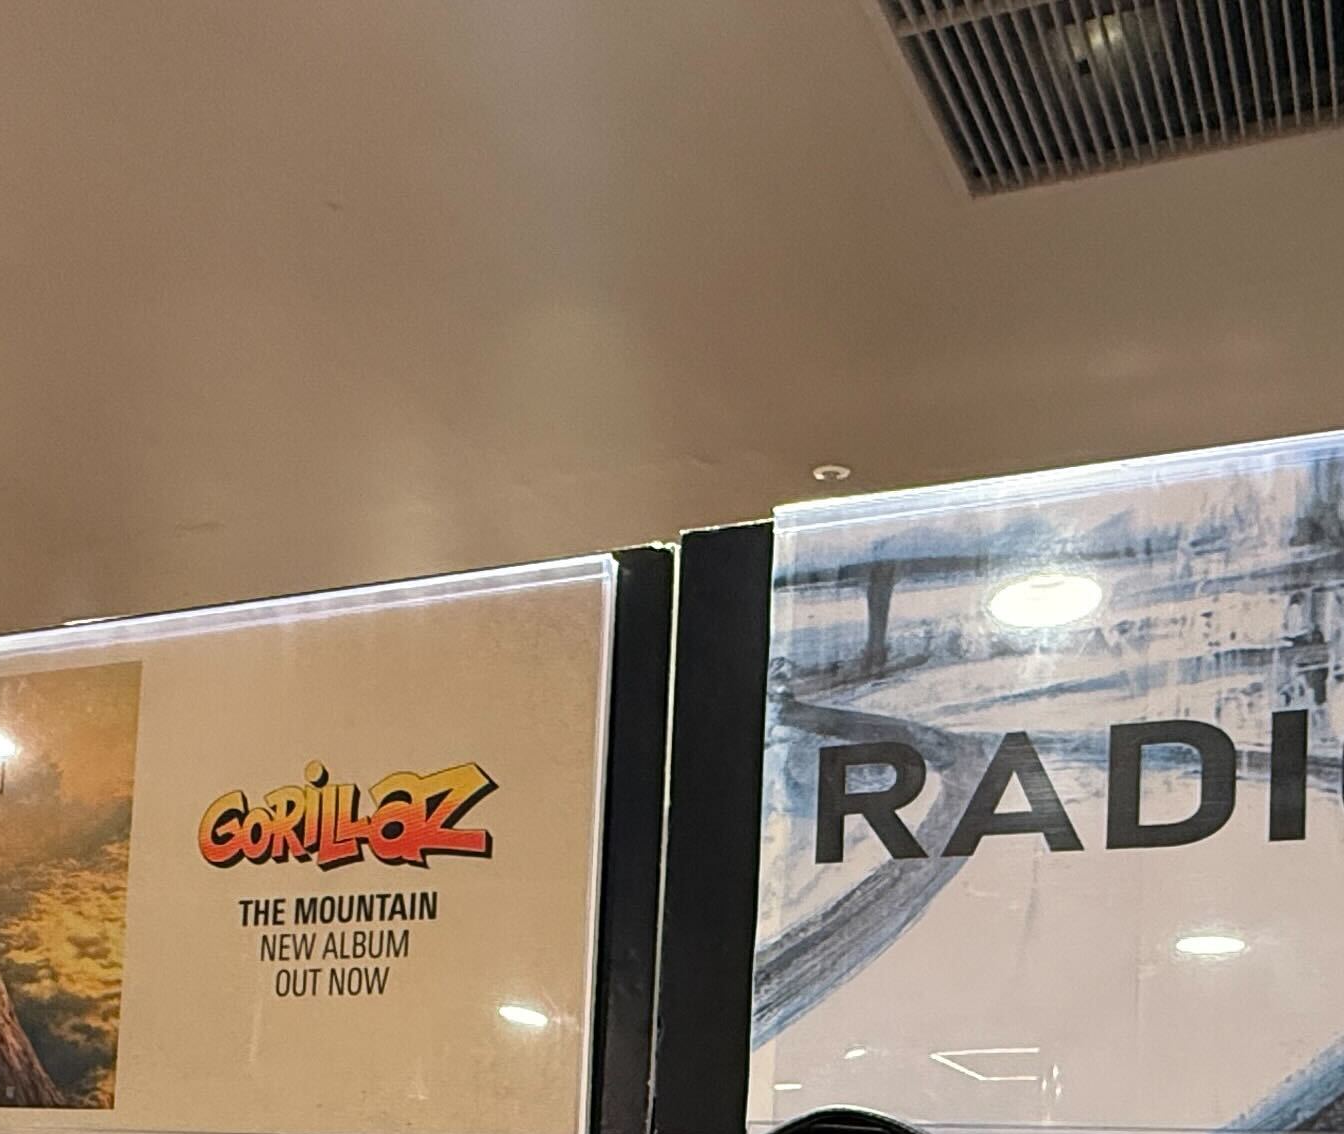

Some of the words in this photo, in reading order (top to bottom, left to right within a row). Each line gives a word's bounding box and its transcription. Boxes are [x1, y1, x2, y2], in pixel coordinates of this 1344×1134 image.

[237, 897, 288, 928] THE
[293, 890, 439, 925] MOUNTAIN
[259, 932, 316, 963] NEW
[321, 928, 410, 961] ALBUM
[274, 969, 324, 999] OUT
[327, 966, 390, 998] NOW
